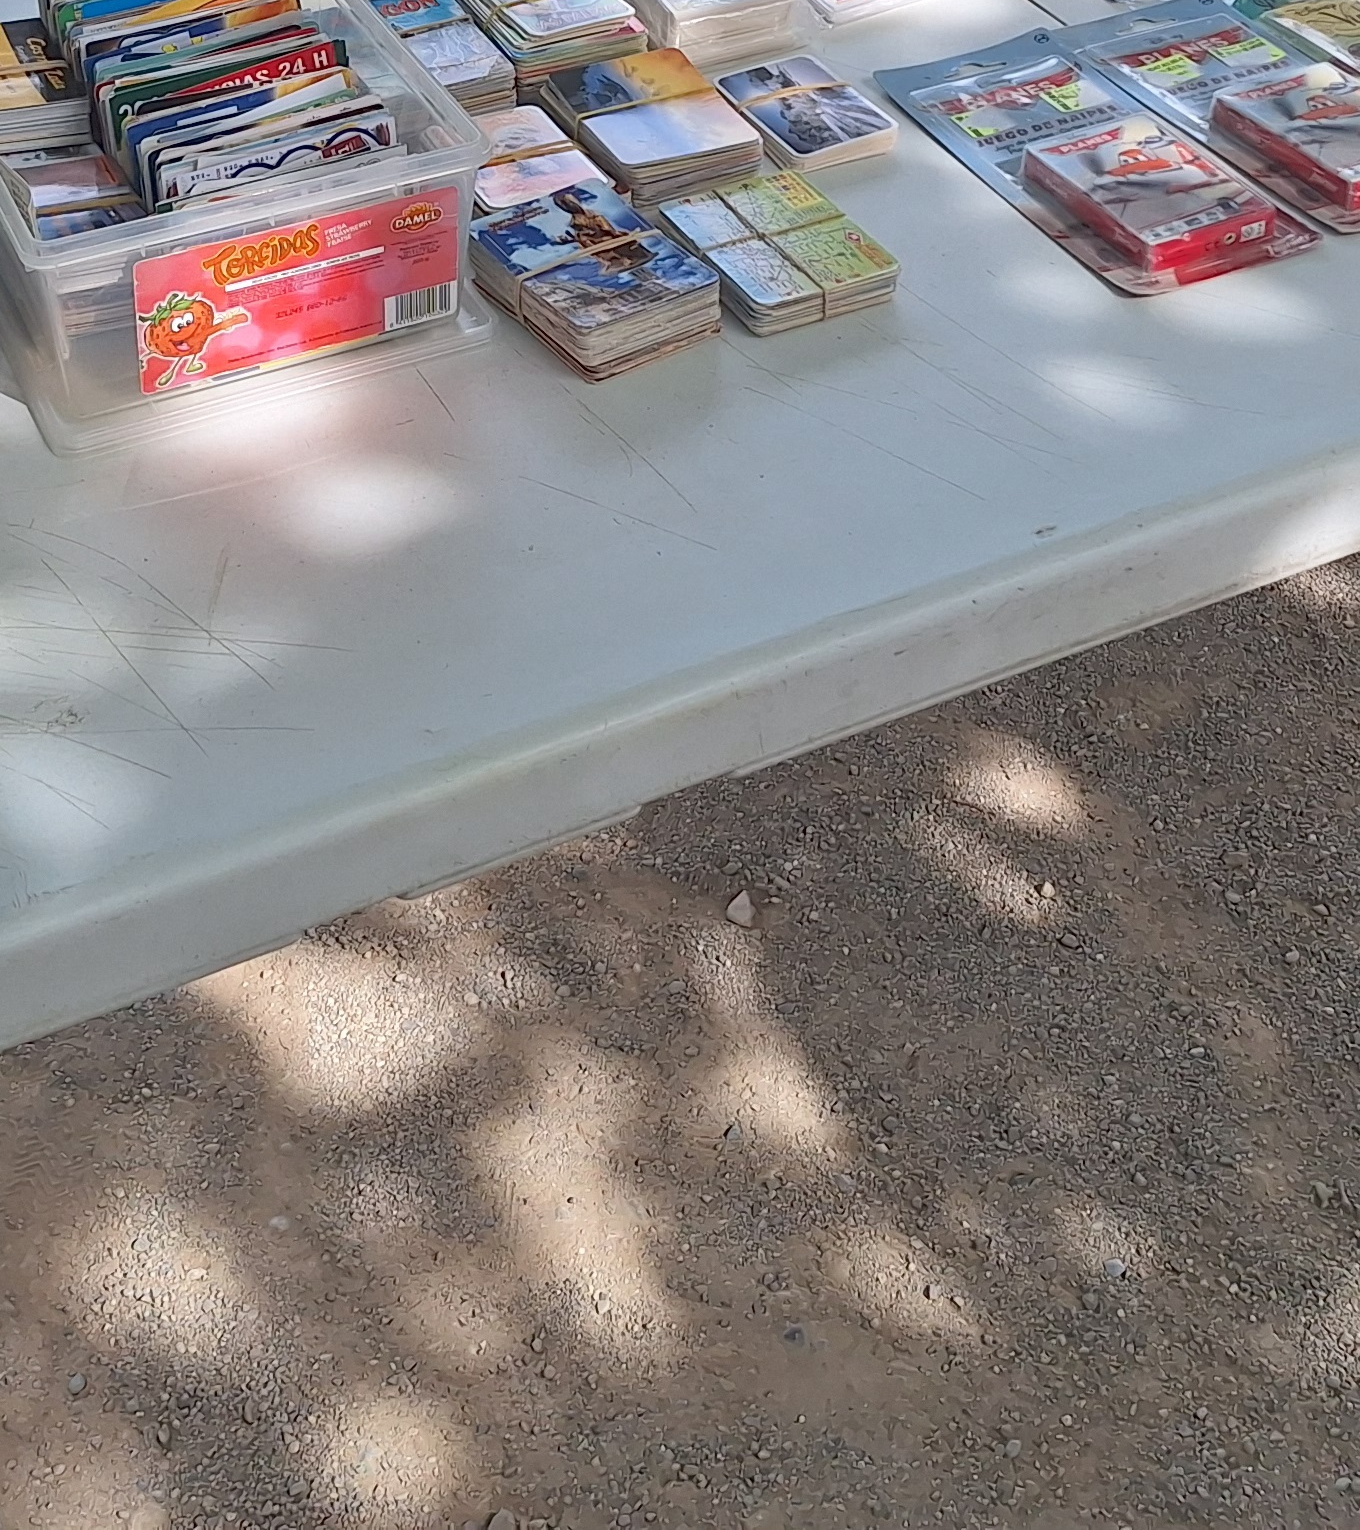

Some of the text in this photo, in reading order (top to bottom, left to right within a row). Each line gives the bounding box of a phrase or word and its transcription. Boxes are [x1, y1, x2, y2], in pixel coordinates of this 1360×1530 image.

[1138, 37, 1229, 65] PLANES
[278, 57, 307, 79] 24
[313, 49, 329, 68] H
[1211, 74, 1231, 84] DE
[1233, 60, 1291, 80] NAIPES
[1247, 80, 1299, 100] PLANES
[976, 104, 1119, 147] JUEGO DE NAIPES
[1058, 134, 1113, 154] PLANES
[324, 222, 348, 236] FRESA
[325, 219, 373, 241] STRAWBERRY
[394, 210, 439, 230] DAMEL
